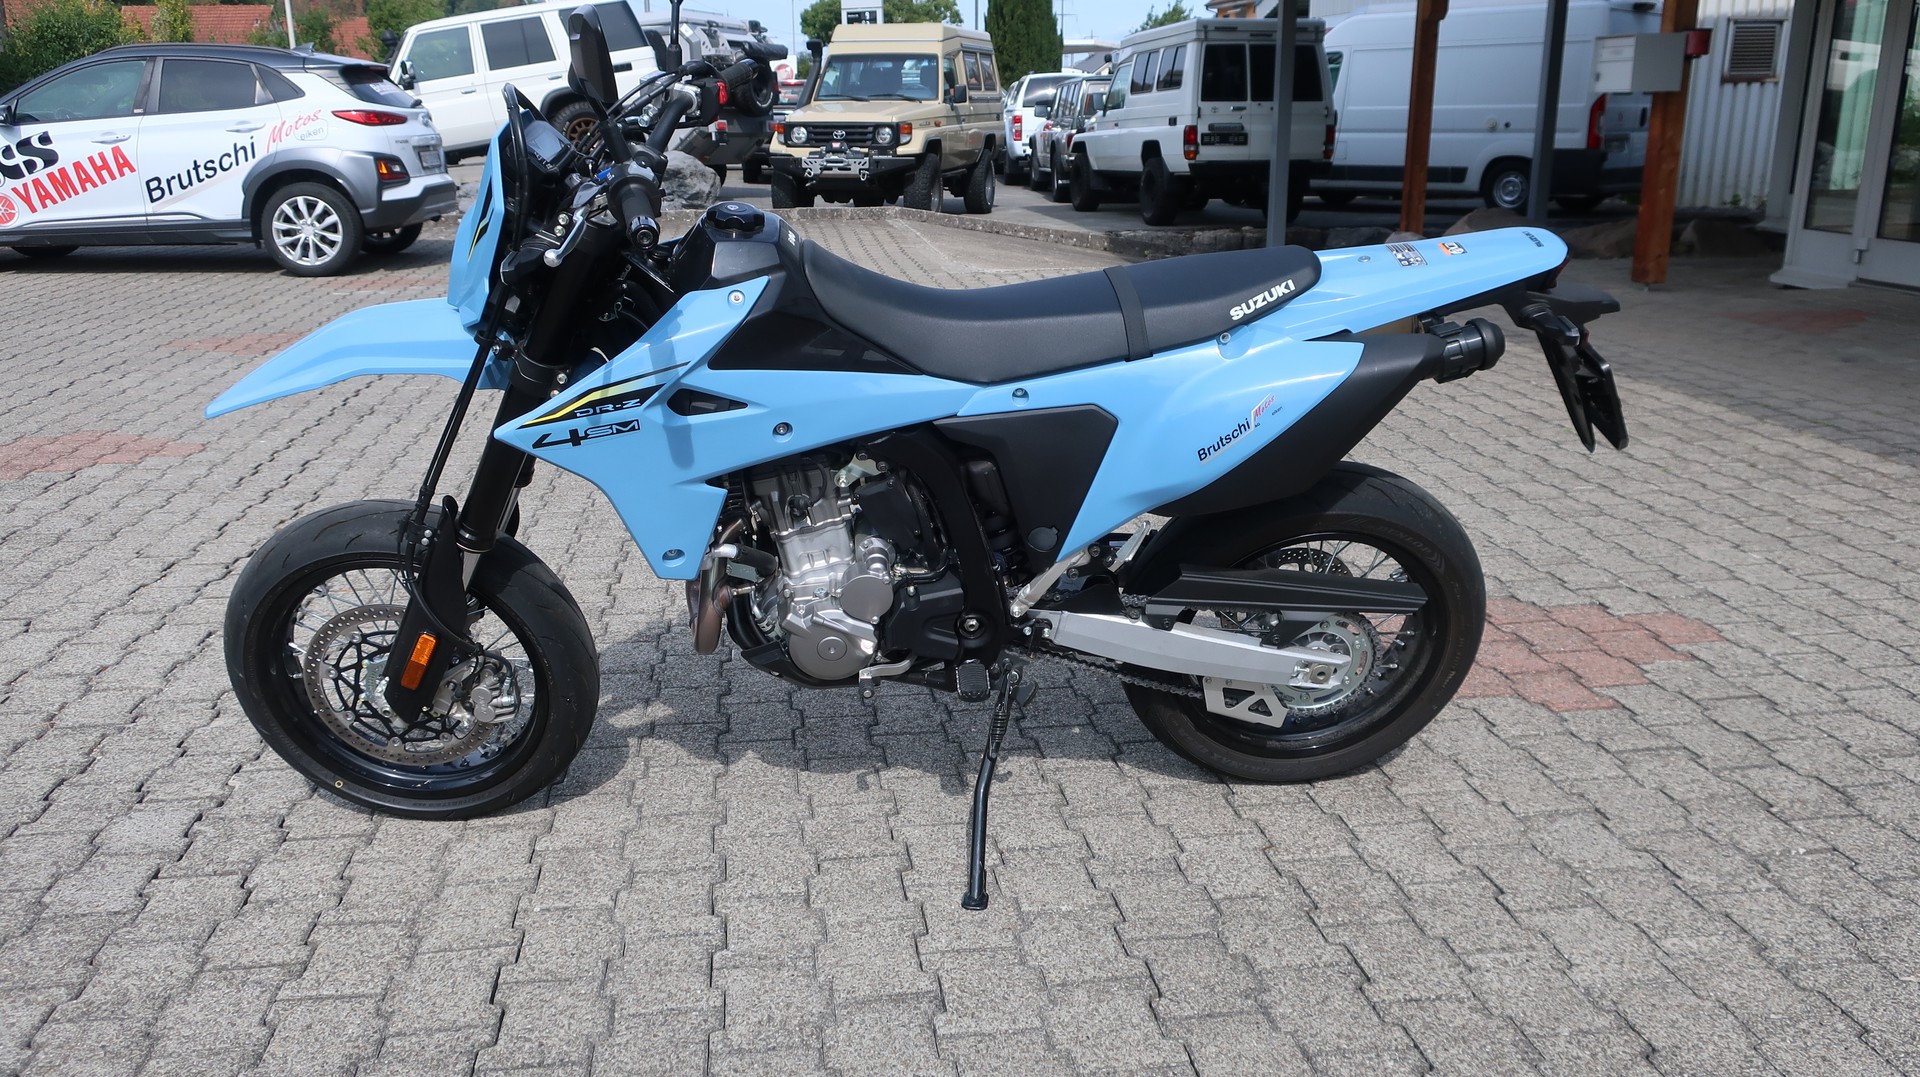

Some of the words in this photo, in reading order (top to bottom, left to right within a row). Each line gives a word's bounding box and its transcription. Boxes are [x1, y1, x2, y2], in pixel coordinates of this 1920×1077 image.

[145, 135, 257, 204] Brutschi
[266, 109, 322, 154] Motos
[10, 145, 137, 214] YAMAHA
[1229, 279, 1296, 321] SUZUKI
[574, 398, 641, 417] DR-Z
[1197, 417, 1251, 462] Brutschi
